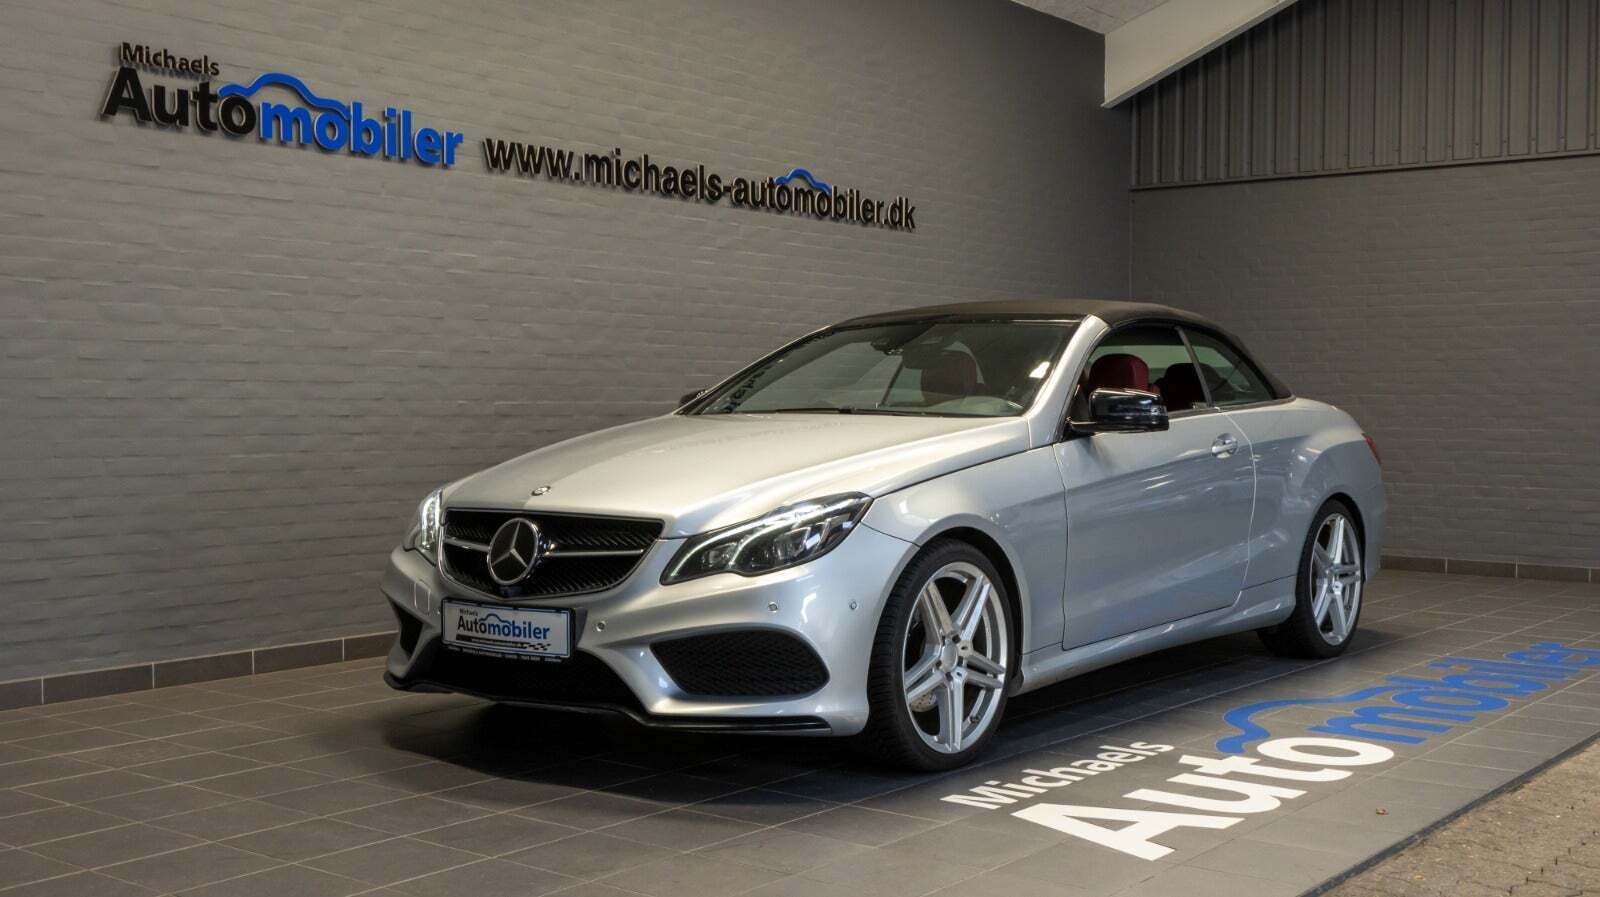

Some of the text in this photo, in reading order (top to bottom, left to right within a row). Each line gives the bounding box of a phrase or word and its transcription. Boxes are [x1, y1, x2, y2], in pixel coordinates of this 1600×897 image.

[119, 41, 219, 76] Michaels
[101, 66, 463, 165] Automobiler
[483, 137, 915, 230] www.michaels-automobiler.dk
[457, 615, 550, 640] Automobiler
[940, 741, 1174, 810] Michaels
